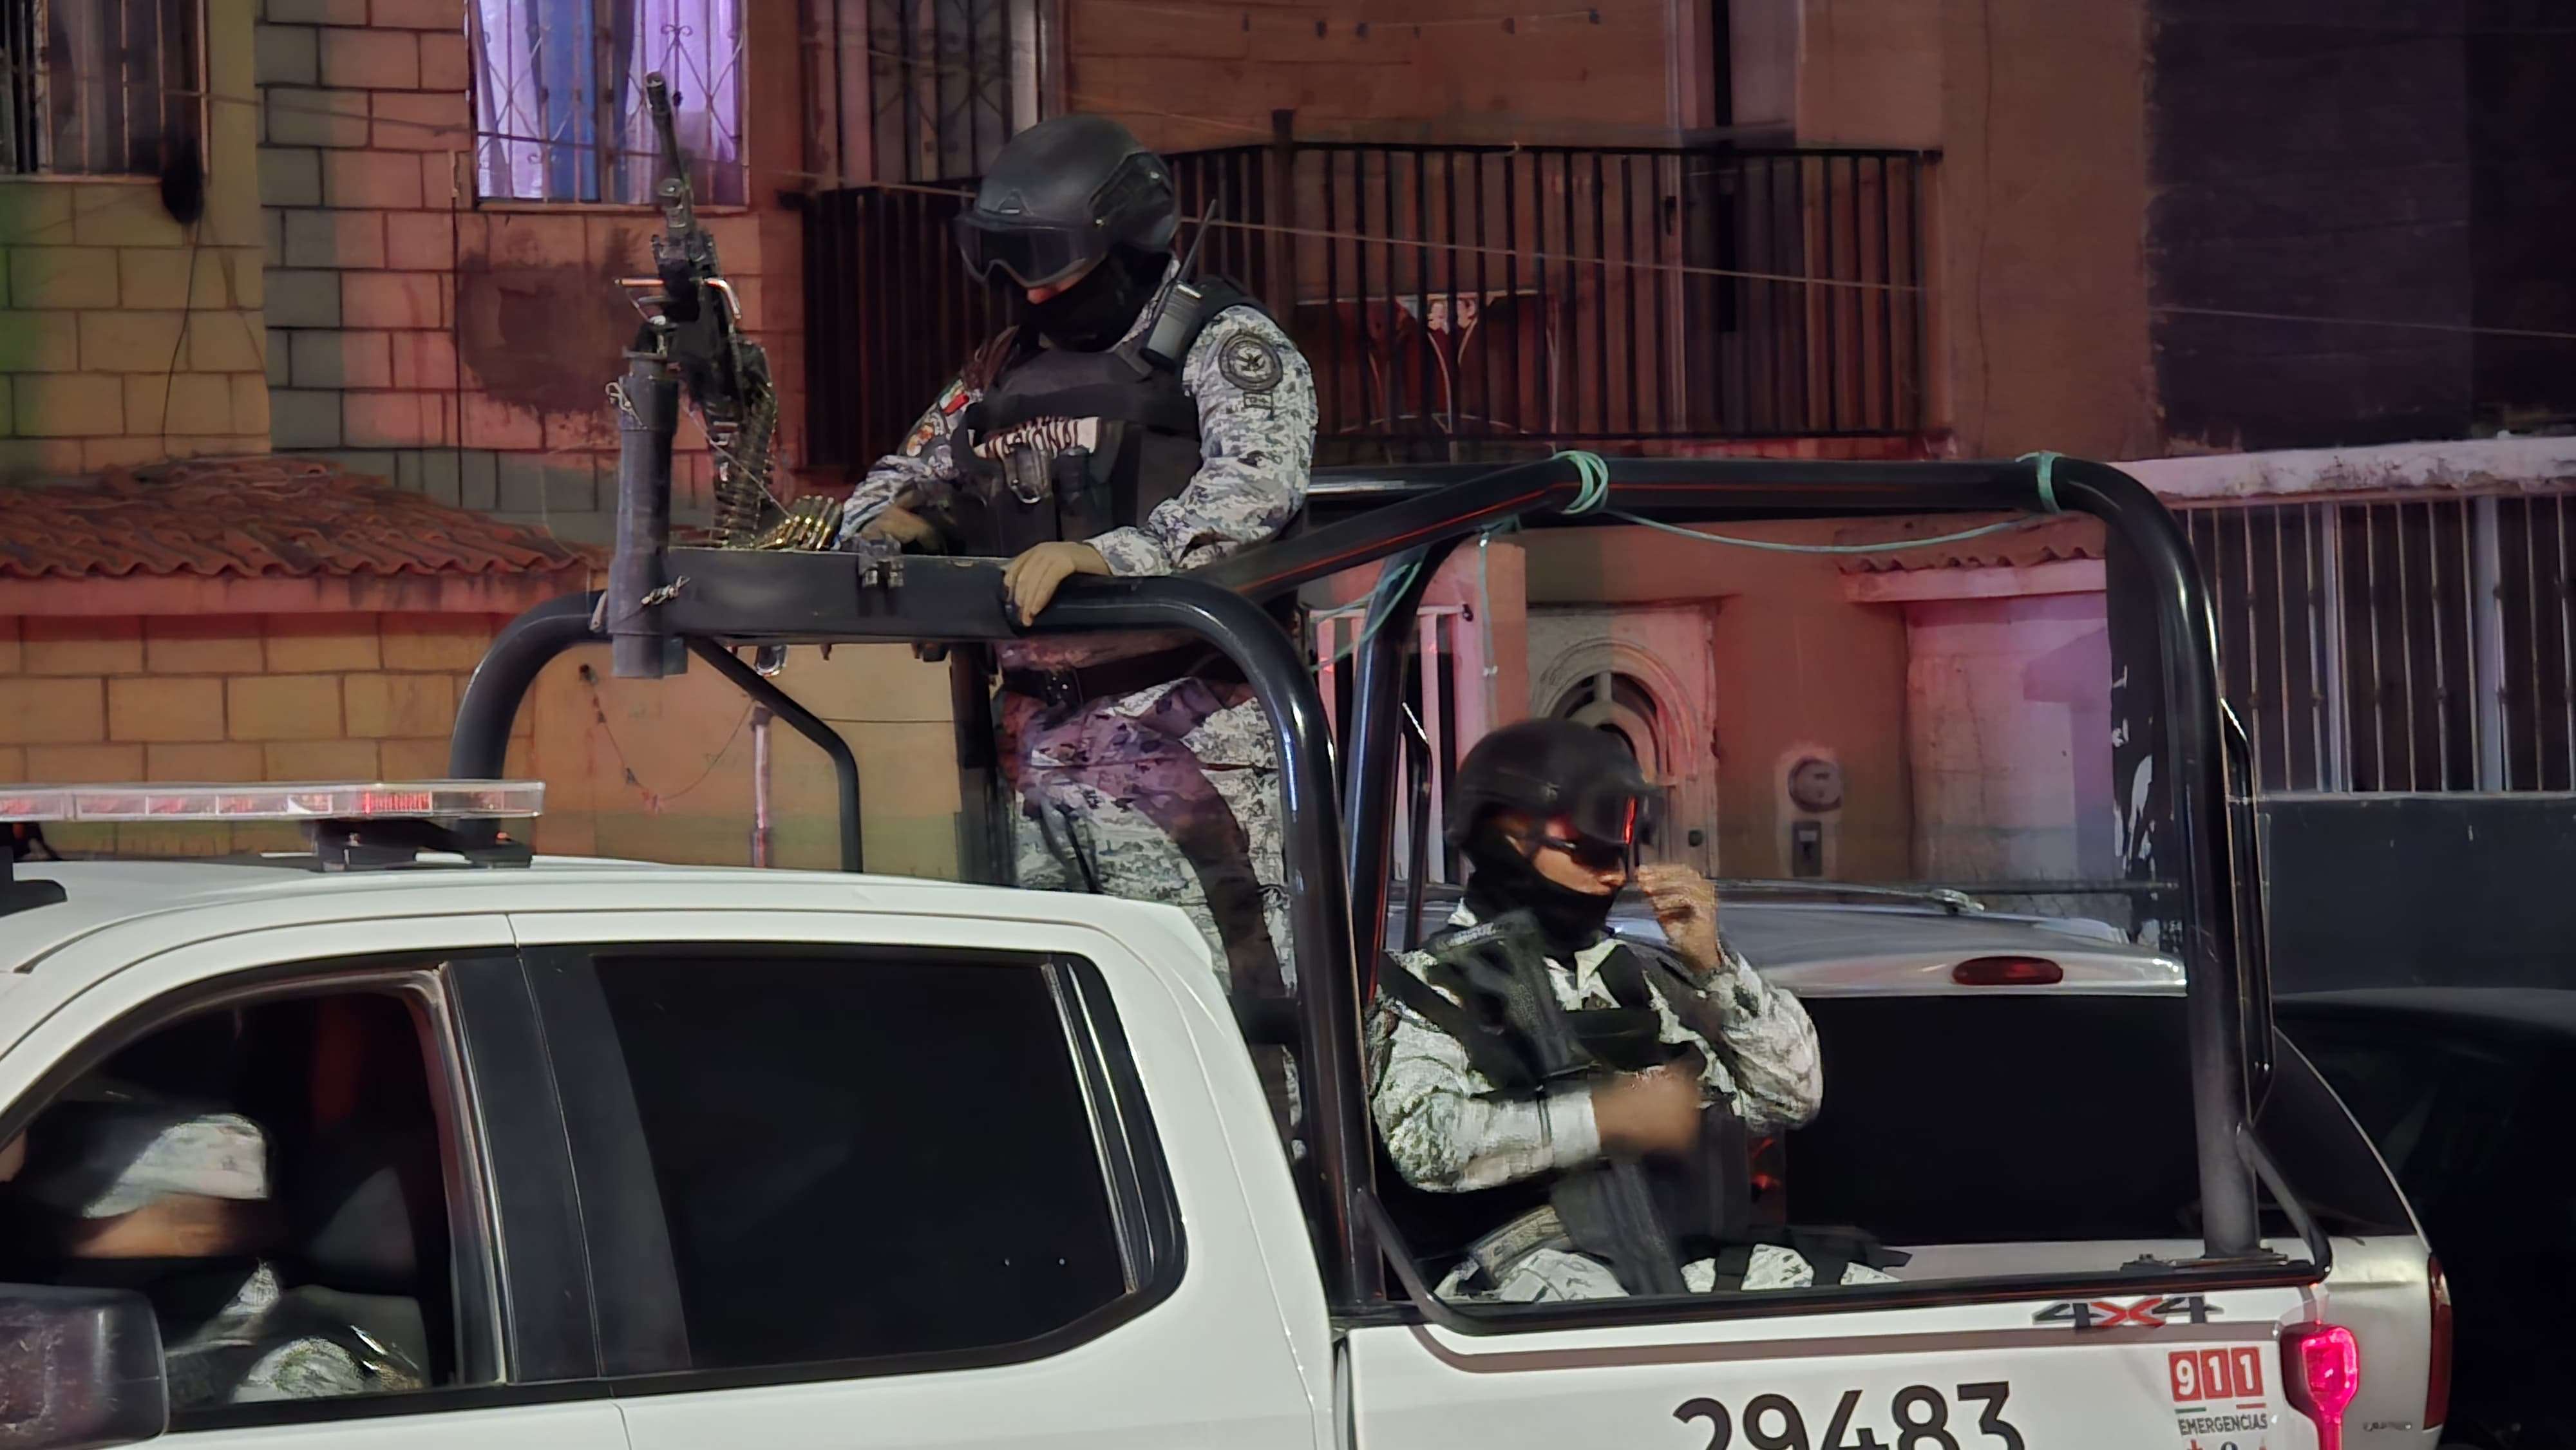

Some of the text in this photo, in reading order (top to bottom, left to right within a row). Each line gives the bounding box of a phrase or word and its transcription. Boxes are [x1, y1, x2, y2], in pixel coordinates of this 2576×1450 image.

[2174, 1352, 2257, 1397] 911
[1672, 1380, 2025, 1450] 29483
[2177, 1413, 2268, 1436] EMERGENCIAS
